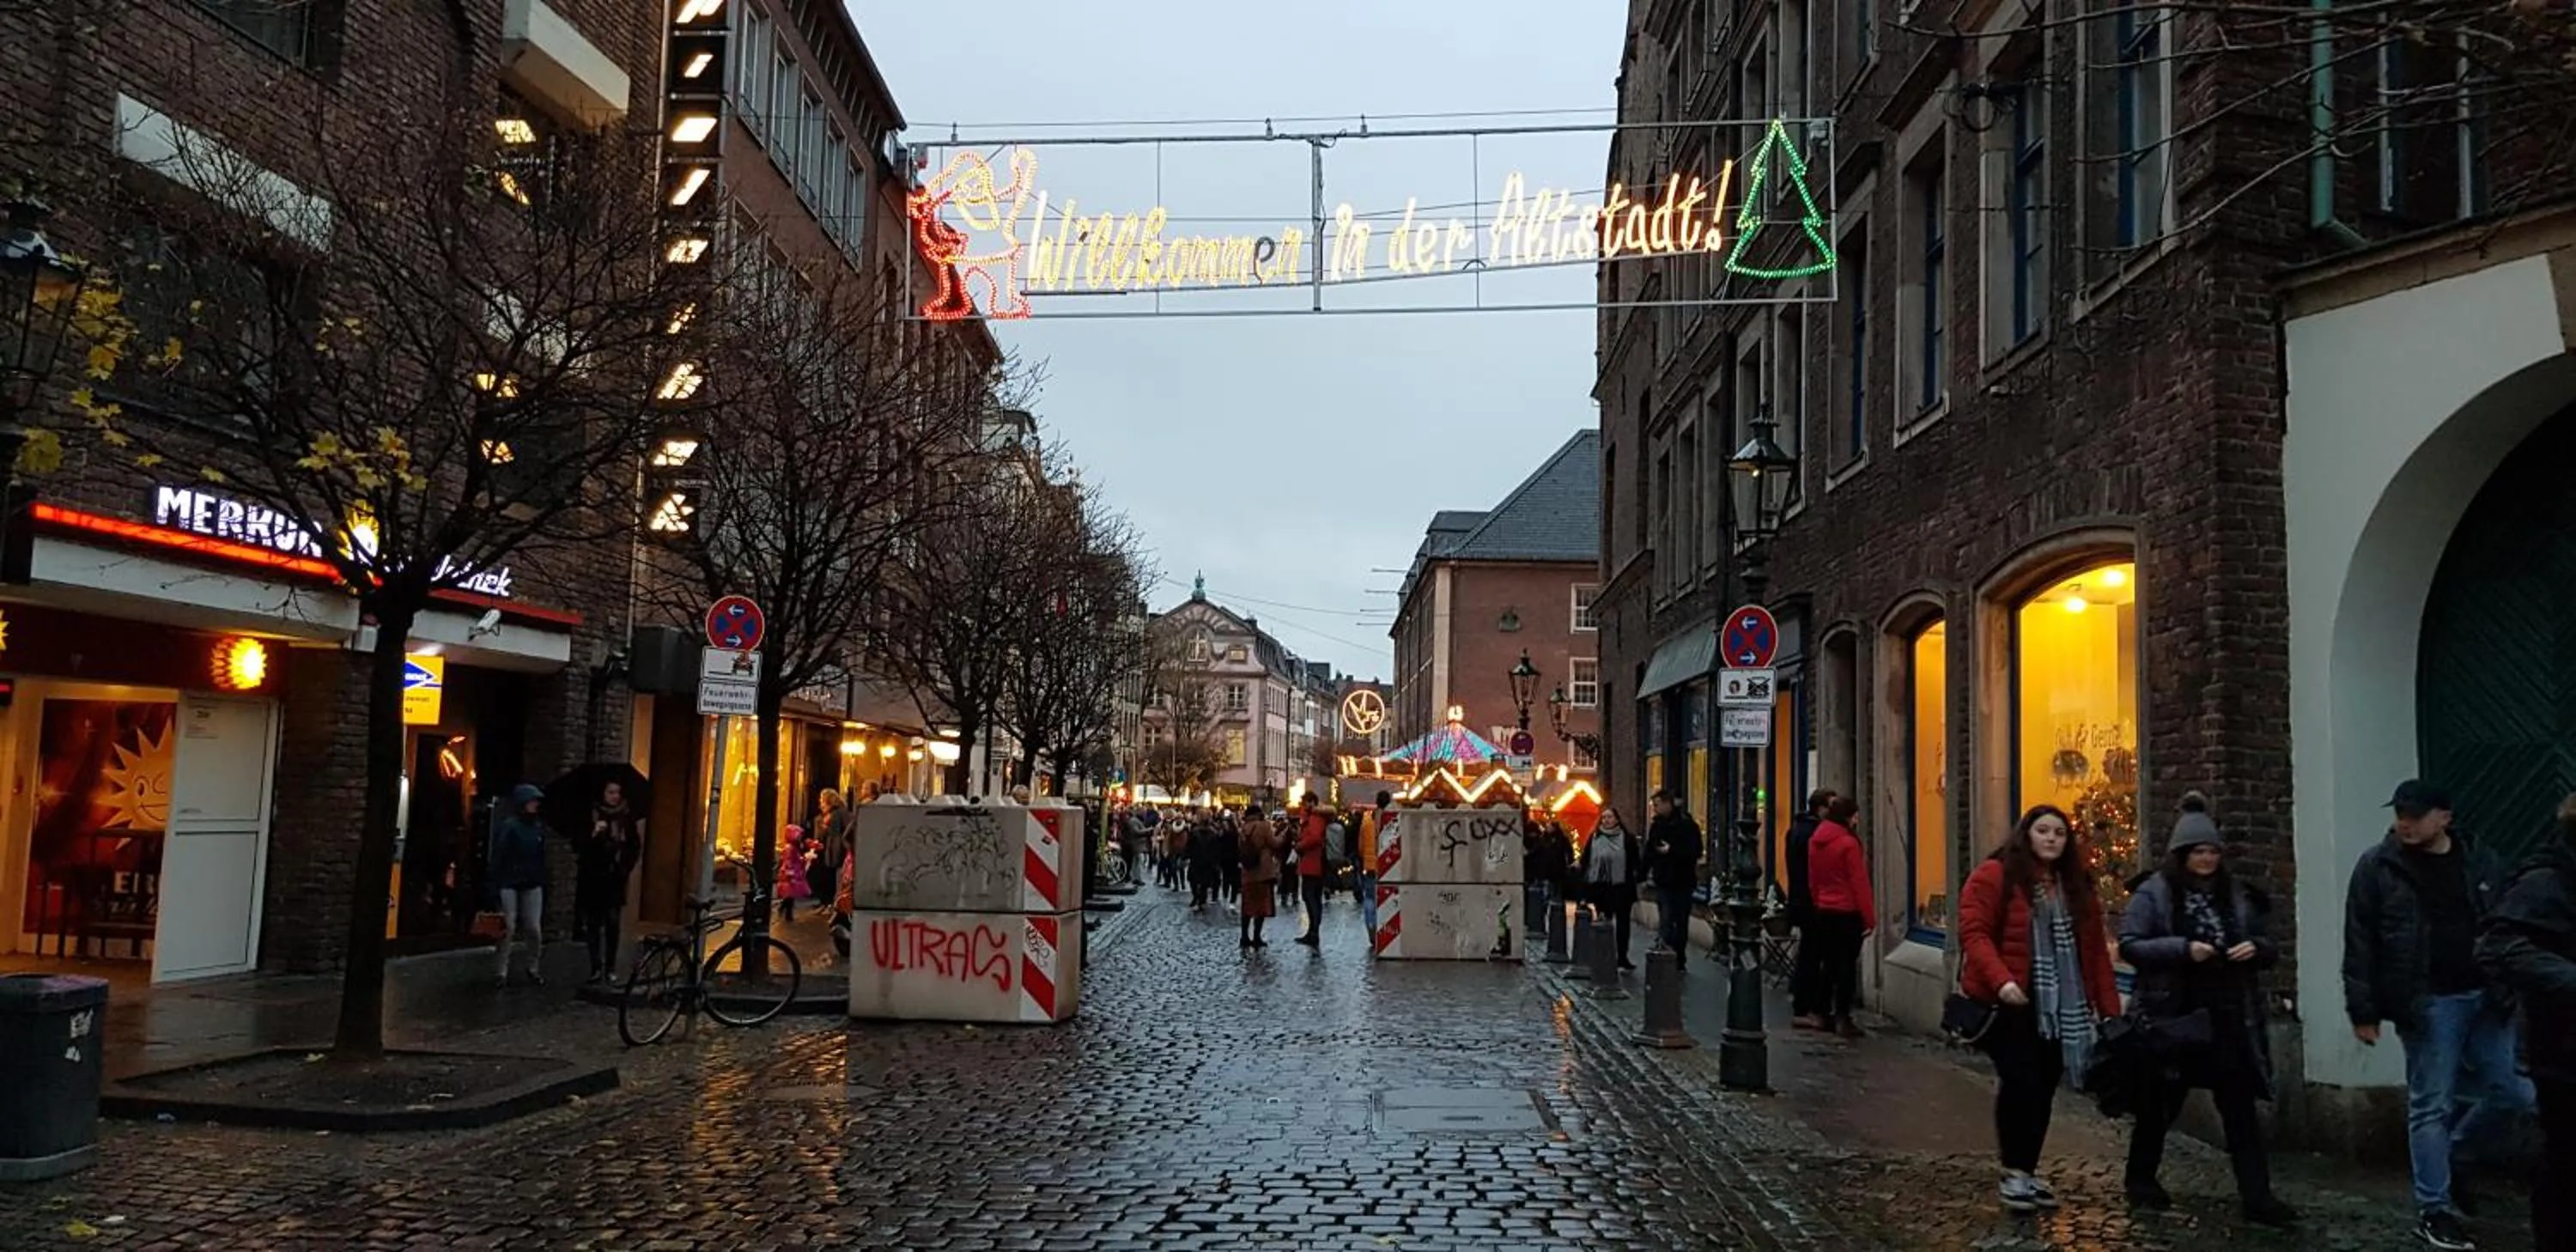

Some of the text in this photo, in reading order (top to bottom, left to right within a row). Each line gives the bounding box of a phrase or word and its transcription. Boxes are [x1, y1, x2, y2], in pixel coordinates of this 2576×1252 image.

[1030, 159, 1734, 291] Willkommen in der Altstadt!
[156, 486, 323, 558] MERKUR
[872, 918, 1012, 992] ULTRAS
